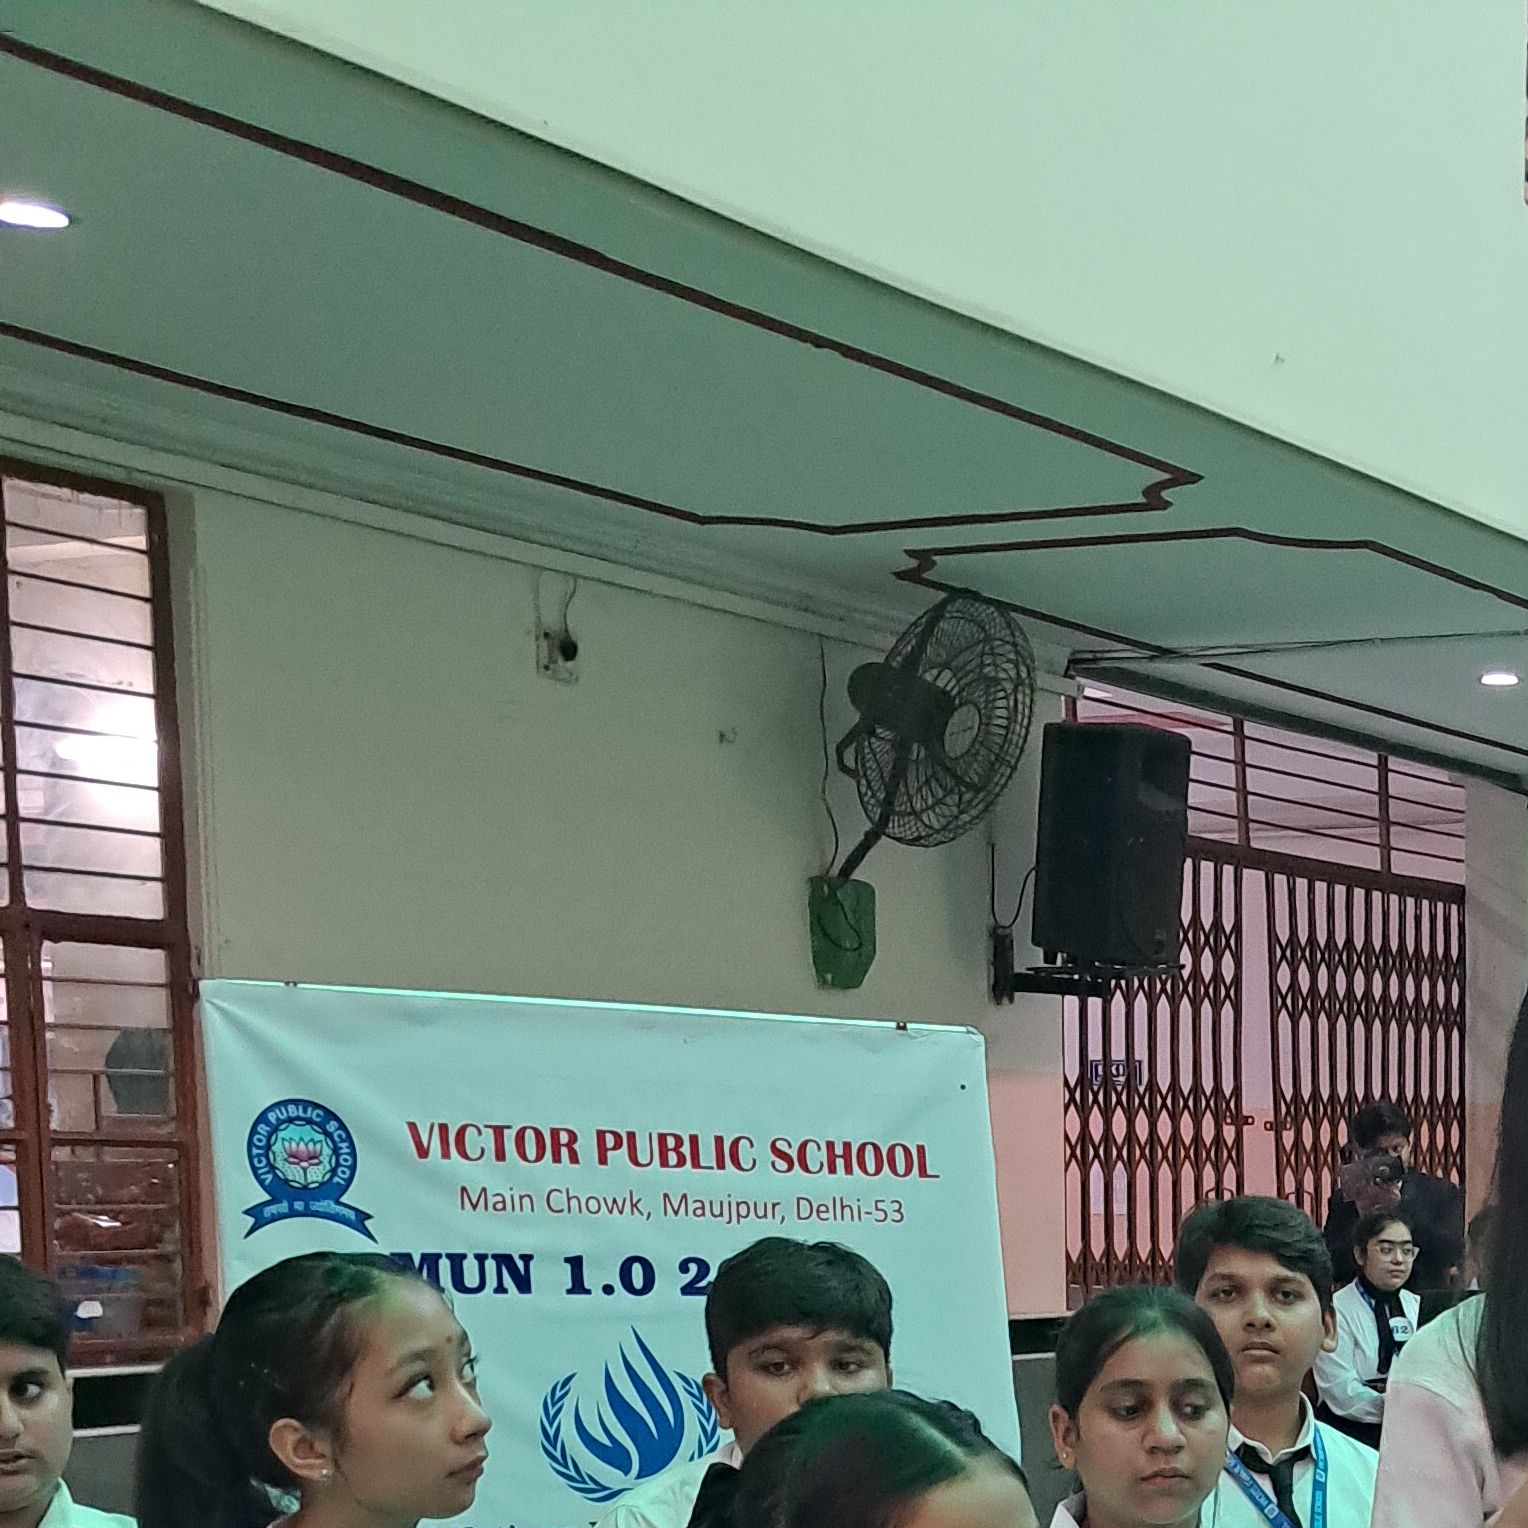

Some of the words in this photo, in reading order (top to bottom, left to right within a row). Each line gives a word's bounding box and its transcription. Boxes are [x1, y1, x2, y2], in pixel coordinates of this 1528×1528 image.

[252, 1123, 273, 1186] VICTOR
[267, 1104, 324, 1124] PUBLIC
[325, 1120, 352, 1186] SCHOOL
[405, 1121, 581, 1165] VICTOR
[595, 1128, 757, 1172] PUBLIC
[769, 1137, 941, 1179] SCHOOL
[460, 1185, 535, 1213] Main
[545, 1187, 652, 1222] Chowk,
[662, 1192, 786, 1226] Maujpur,
[795, 1196, 905, 1223] Delhi-53
[563, 1254, 657, 1297] 1.0
